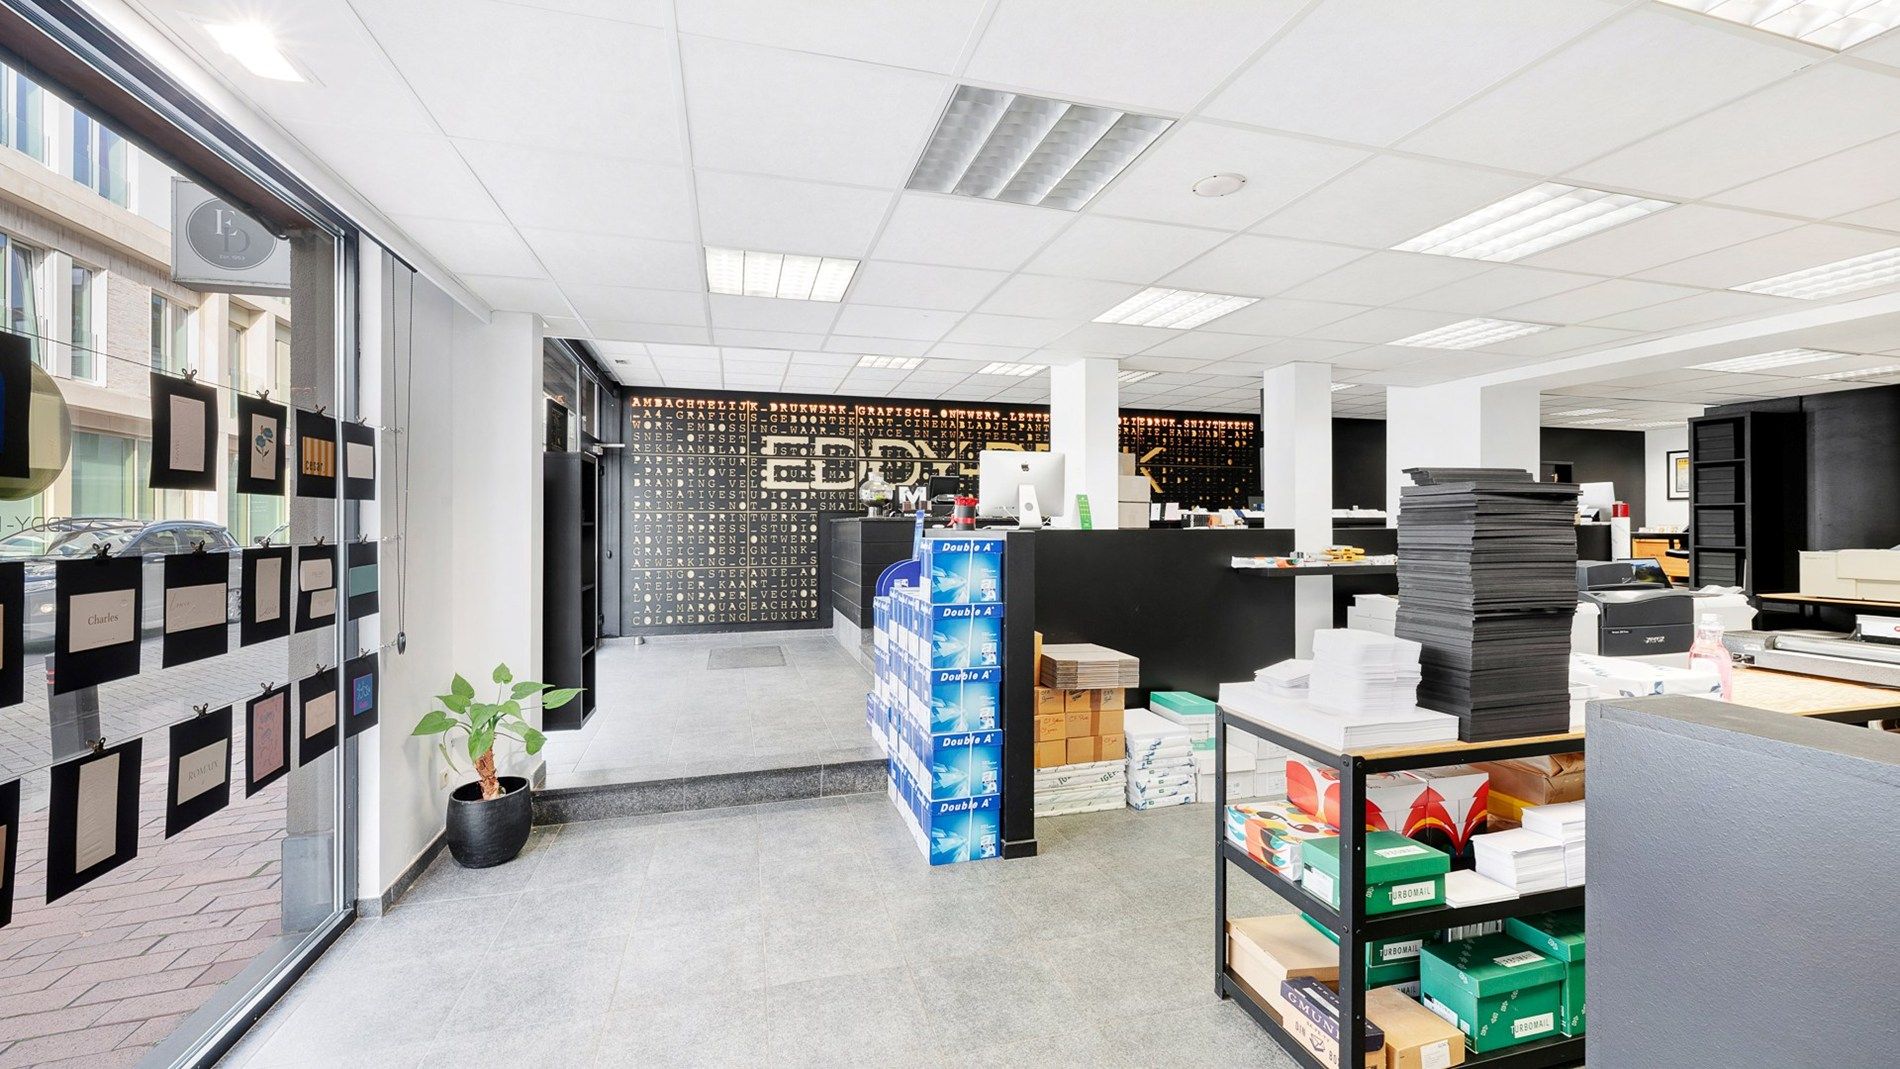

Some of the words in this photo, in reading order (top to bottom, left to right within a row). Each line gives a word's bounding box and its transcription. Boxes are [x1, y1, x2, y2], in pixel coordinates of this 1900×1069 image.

[632, 397, 758, 412] AMBACHTELIJK
[770, 403, 847, 415] DRUKWERK
[858, 406, 930, 418] GRAFISCH
[940, 409, 1000, 420] ONTWERP
[676, 411, 758, 422] GRAFICUS
[770, 414, 894, 427] GEBOORTEKAART
[632, 421, 677, 430] WORK
[686, 422, 778, 434] EMBOSSING
[789, 426, 828, 436] WAAR
[839, 428, 903, 438] SERVICE
[940, 430, 1017, 441] KWALITEIT
[633, 432, 674, 441] SNEE
[686, 434, 747, 443] OFFSET
[632, 443, 747, 454] REKLAAMBLAD
[633, 456, 758, 467] PAPERTEXTURE
[644, 467, 737, 478] PAPERLOVE
[633, 479, 716, 489] BRANDING
[643, 490, 788, 500] CREATIVESTUDIO
[634, 501, 684, 510] PRINT
[729, 501, 758, 511] NOT
[770, 501, 807, 511] DEAD
[633, 513, 695, 522] PAPIER
[709, 513, 798, 523] PRINTWERK
[633, 524, 747, 534] LETTERPRESS
[761, 524, 818, 533] STUDIO
[632, 535, 736, 545] ADVERTEREN
[750, 535, 818, 544] ONTWERP
[632, 546, 695, 556] GRAFIC
[709, 545, 768, 556] DESIGN
[782, 546, 808, 555] INK
[942, 542, 980, 552] Double
[632, 557, 726, 568] AFWERKING
[739, 556, 798, 566] CLICHE
[644, 570, 695, 580] RINGO
[708, 568, 788, 578] STEFANIE
[632, 581, 705, 592] ATELIER
[719, 580, 768, 589] KAART
[781, 578, 818, 588] LUXE
[633, 590, 747, 603] LOVEONPAPER
[760, 589, 818, 599] VECTOR
[942, 606, 981, 617] Double
[87, 612, 119, 626] Charles
[632, 613, 747, 625] COLOREDGING
[761, 611, 818, 620] LUXURY
[940, 671, 979, 682] Double
[942, 735, 981, 747] Double
[940, 801, 979, 813] Double
[1388, 886, 1431, 901] TURBOMAIL
[1510, 1019, 1551, 1036] TURBOMAIL
